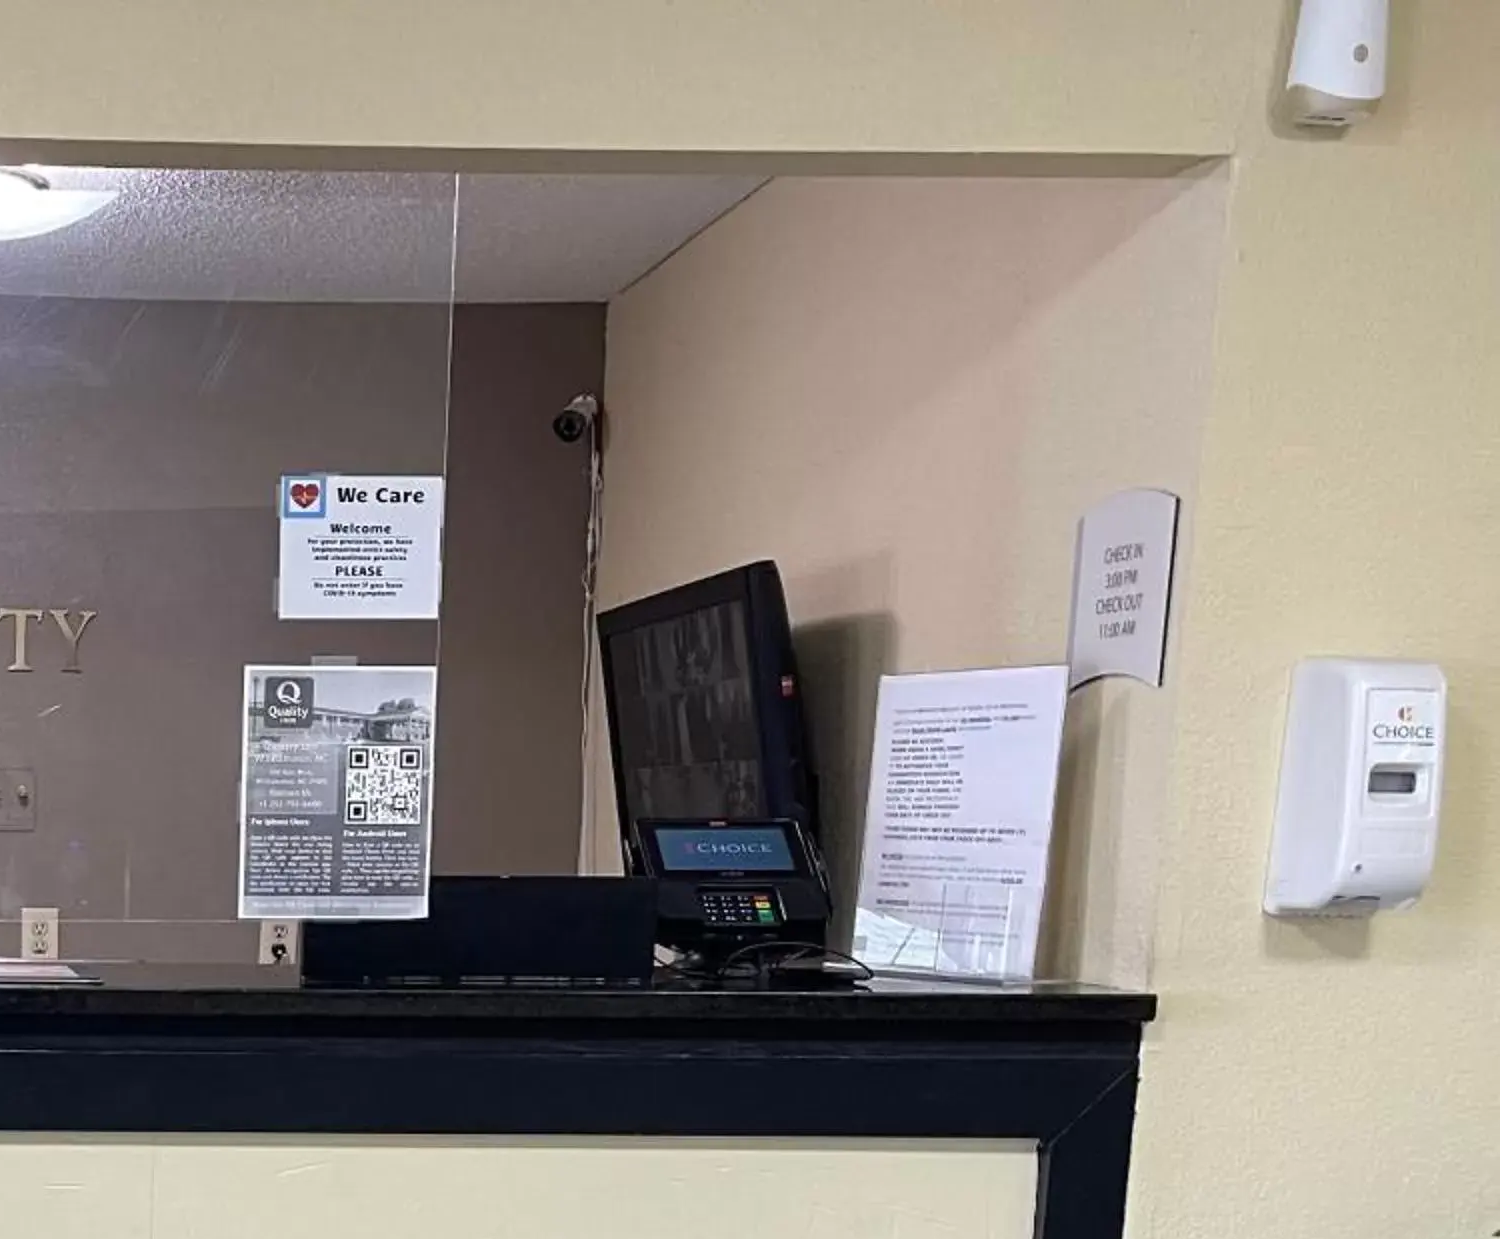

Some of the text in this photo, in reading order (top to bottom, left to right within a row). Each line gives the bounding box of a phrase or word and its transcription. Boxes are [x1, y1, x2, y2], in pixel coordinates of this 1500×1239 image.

[337, 487, 426, 503] We Care
[329, 523, 392, 534] Welcome
[1103, 543, 1144, 564] CHECK IN
[334, 565, 385, 577] PLEASE
[1123, 569, 1139, 585] PM
[1095, 592, 1144, 615] CHECK OUT
[1121, 619, 1137, 635] AM
[267, 705, 309, 719] Quality
[1372, 723, 1436, 739] CHOICE
[697, 843, 773, 853] CHOICE
